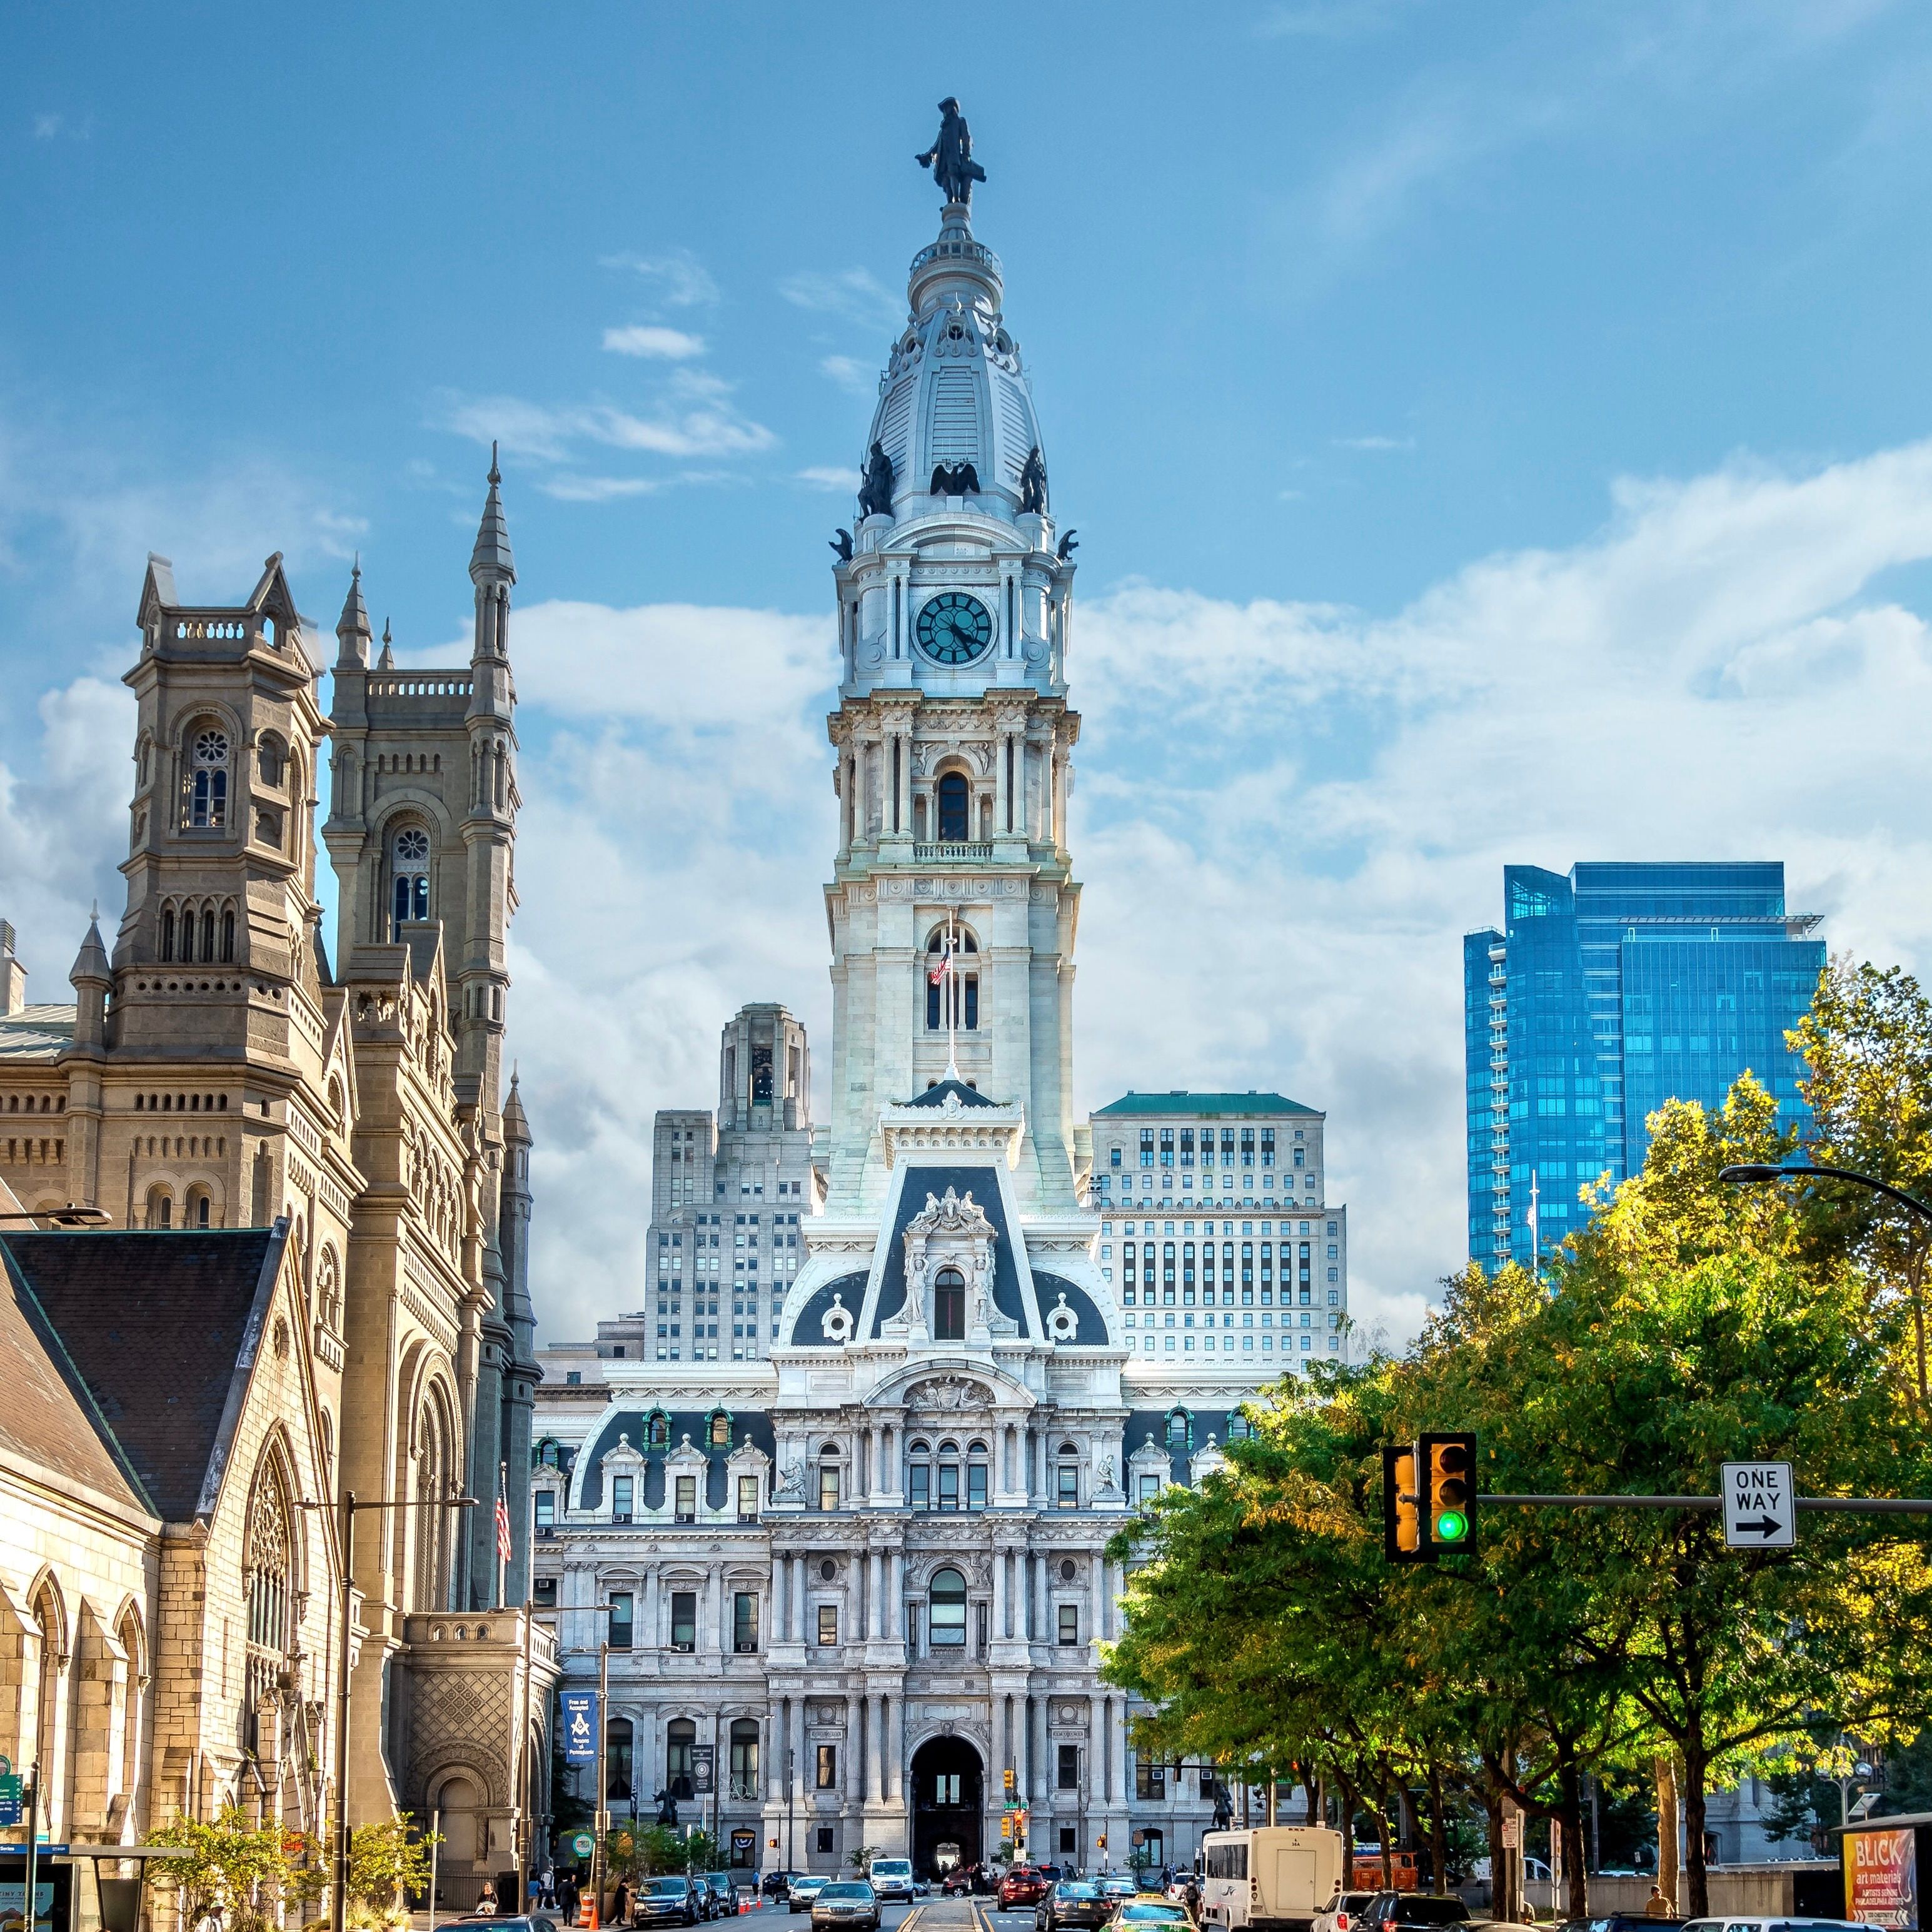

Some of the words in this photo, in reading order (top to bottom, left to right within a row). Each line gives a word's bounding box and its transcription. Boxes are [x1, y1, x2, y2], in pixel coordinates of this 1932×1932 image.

[1736, 1471, 1778, 1489] ONE
[1736, 1493, 1781, 1510] WAY
[1856, 1839, 1902, 1867] BLICK
[1856, 1872, 1868, 1884] art
[1869, 1870, 1901, 1884] materials
[1862, 1889, 1881, 1897] ARTISTS
[1888, 1897, 1904, 1905] ARTISTS
